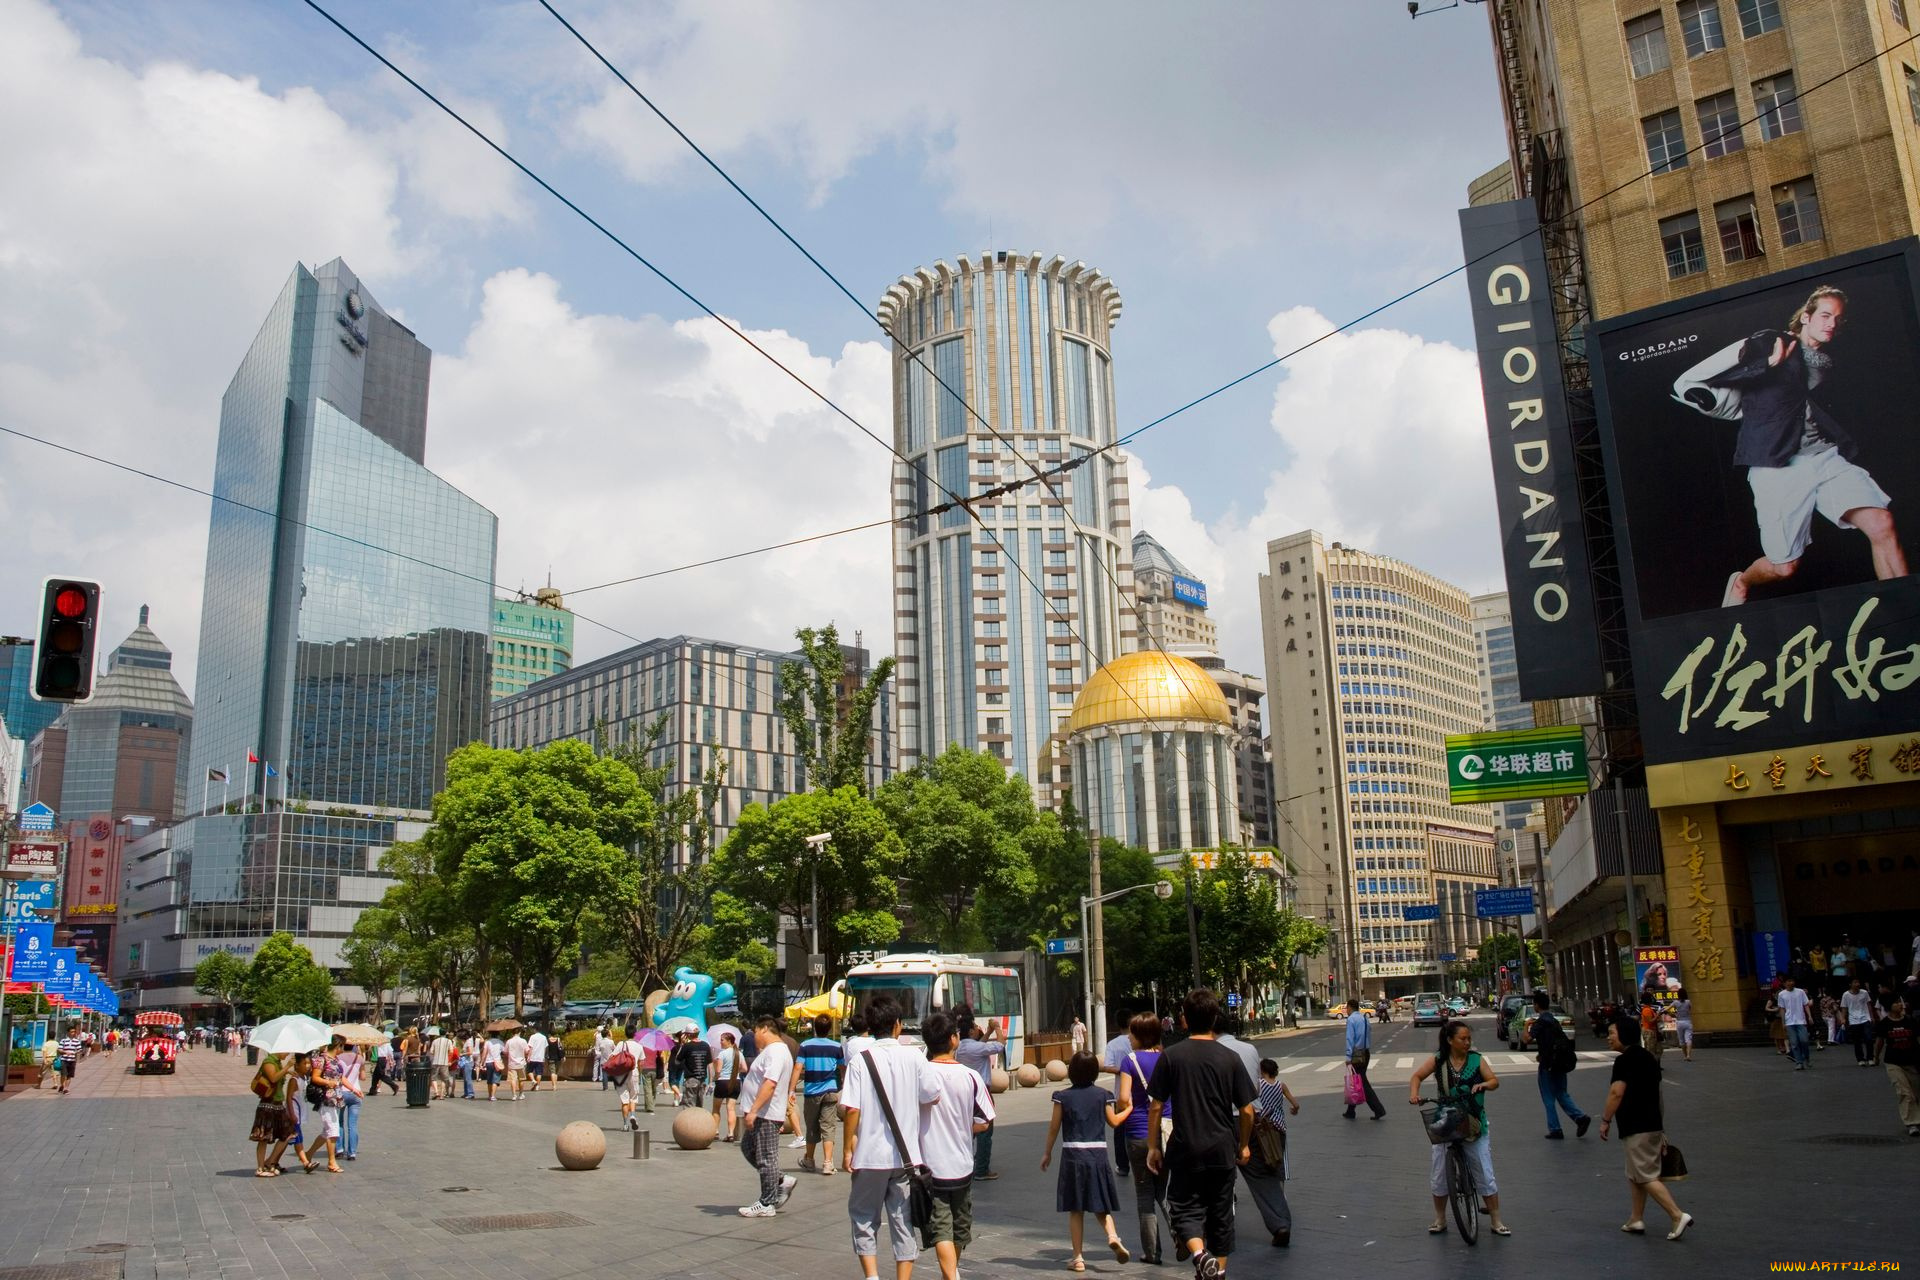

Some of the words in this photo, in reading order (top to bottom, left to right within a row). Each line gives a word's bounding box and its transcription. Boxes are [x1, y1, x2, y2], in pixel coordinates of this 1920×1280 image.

[1619, 334, 1698, 360] GIORDANO
[1632, 344, 1688, 362] e-giordano.com
[1487, 264, 1569, 622] GIORDANO
[1175, 581, 1206, 603] 中国外运
[1489, 750, 1574, 776] 华联超市
[87, 848, 105, 896] 新世界
[1639, 950, 1676, 961] 反季特卖
